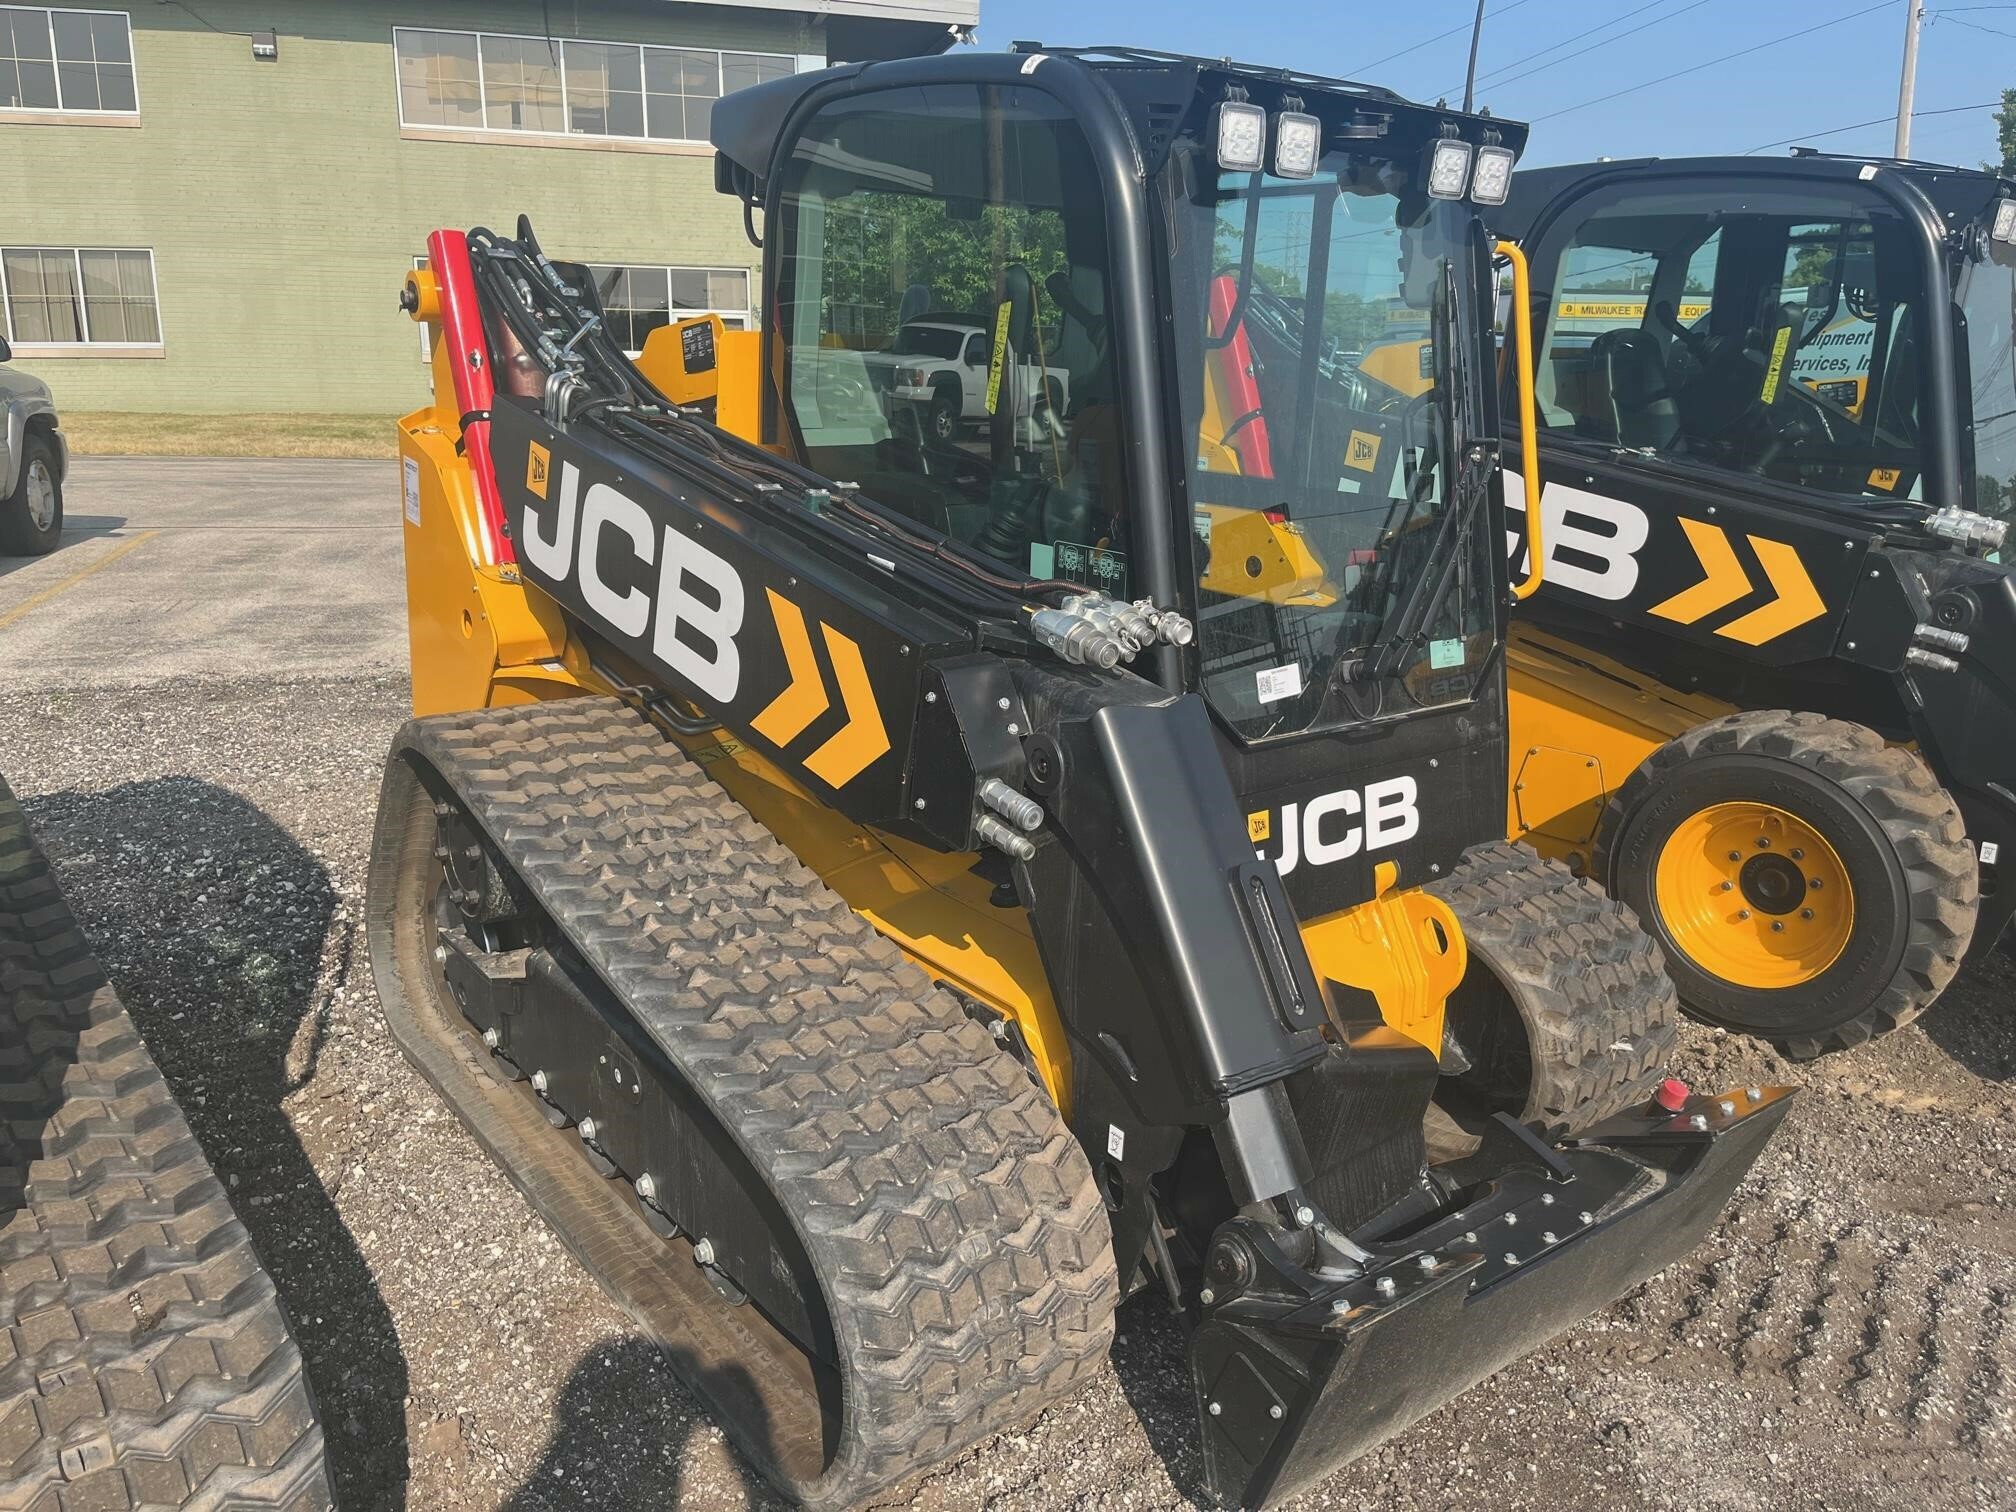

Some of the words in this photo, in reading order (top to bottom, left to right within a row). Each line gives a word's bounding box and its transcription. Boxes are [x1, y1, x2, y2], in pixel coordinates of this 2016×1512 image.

[1580, 305, 1631, 316] MILWAUKEE
[1811, 329, 1874, 350] uipment
[1791, 355, 1851, 375] ervices,
[1355, 441, 1373, 459] JCB
[533, 455, 545, 480] JCB
[522, 459, 745, 704] JCB
[1254, 819, 1266, 834] JCB
[1255, 775, 1420, 877] JCB
